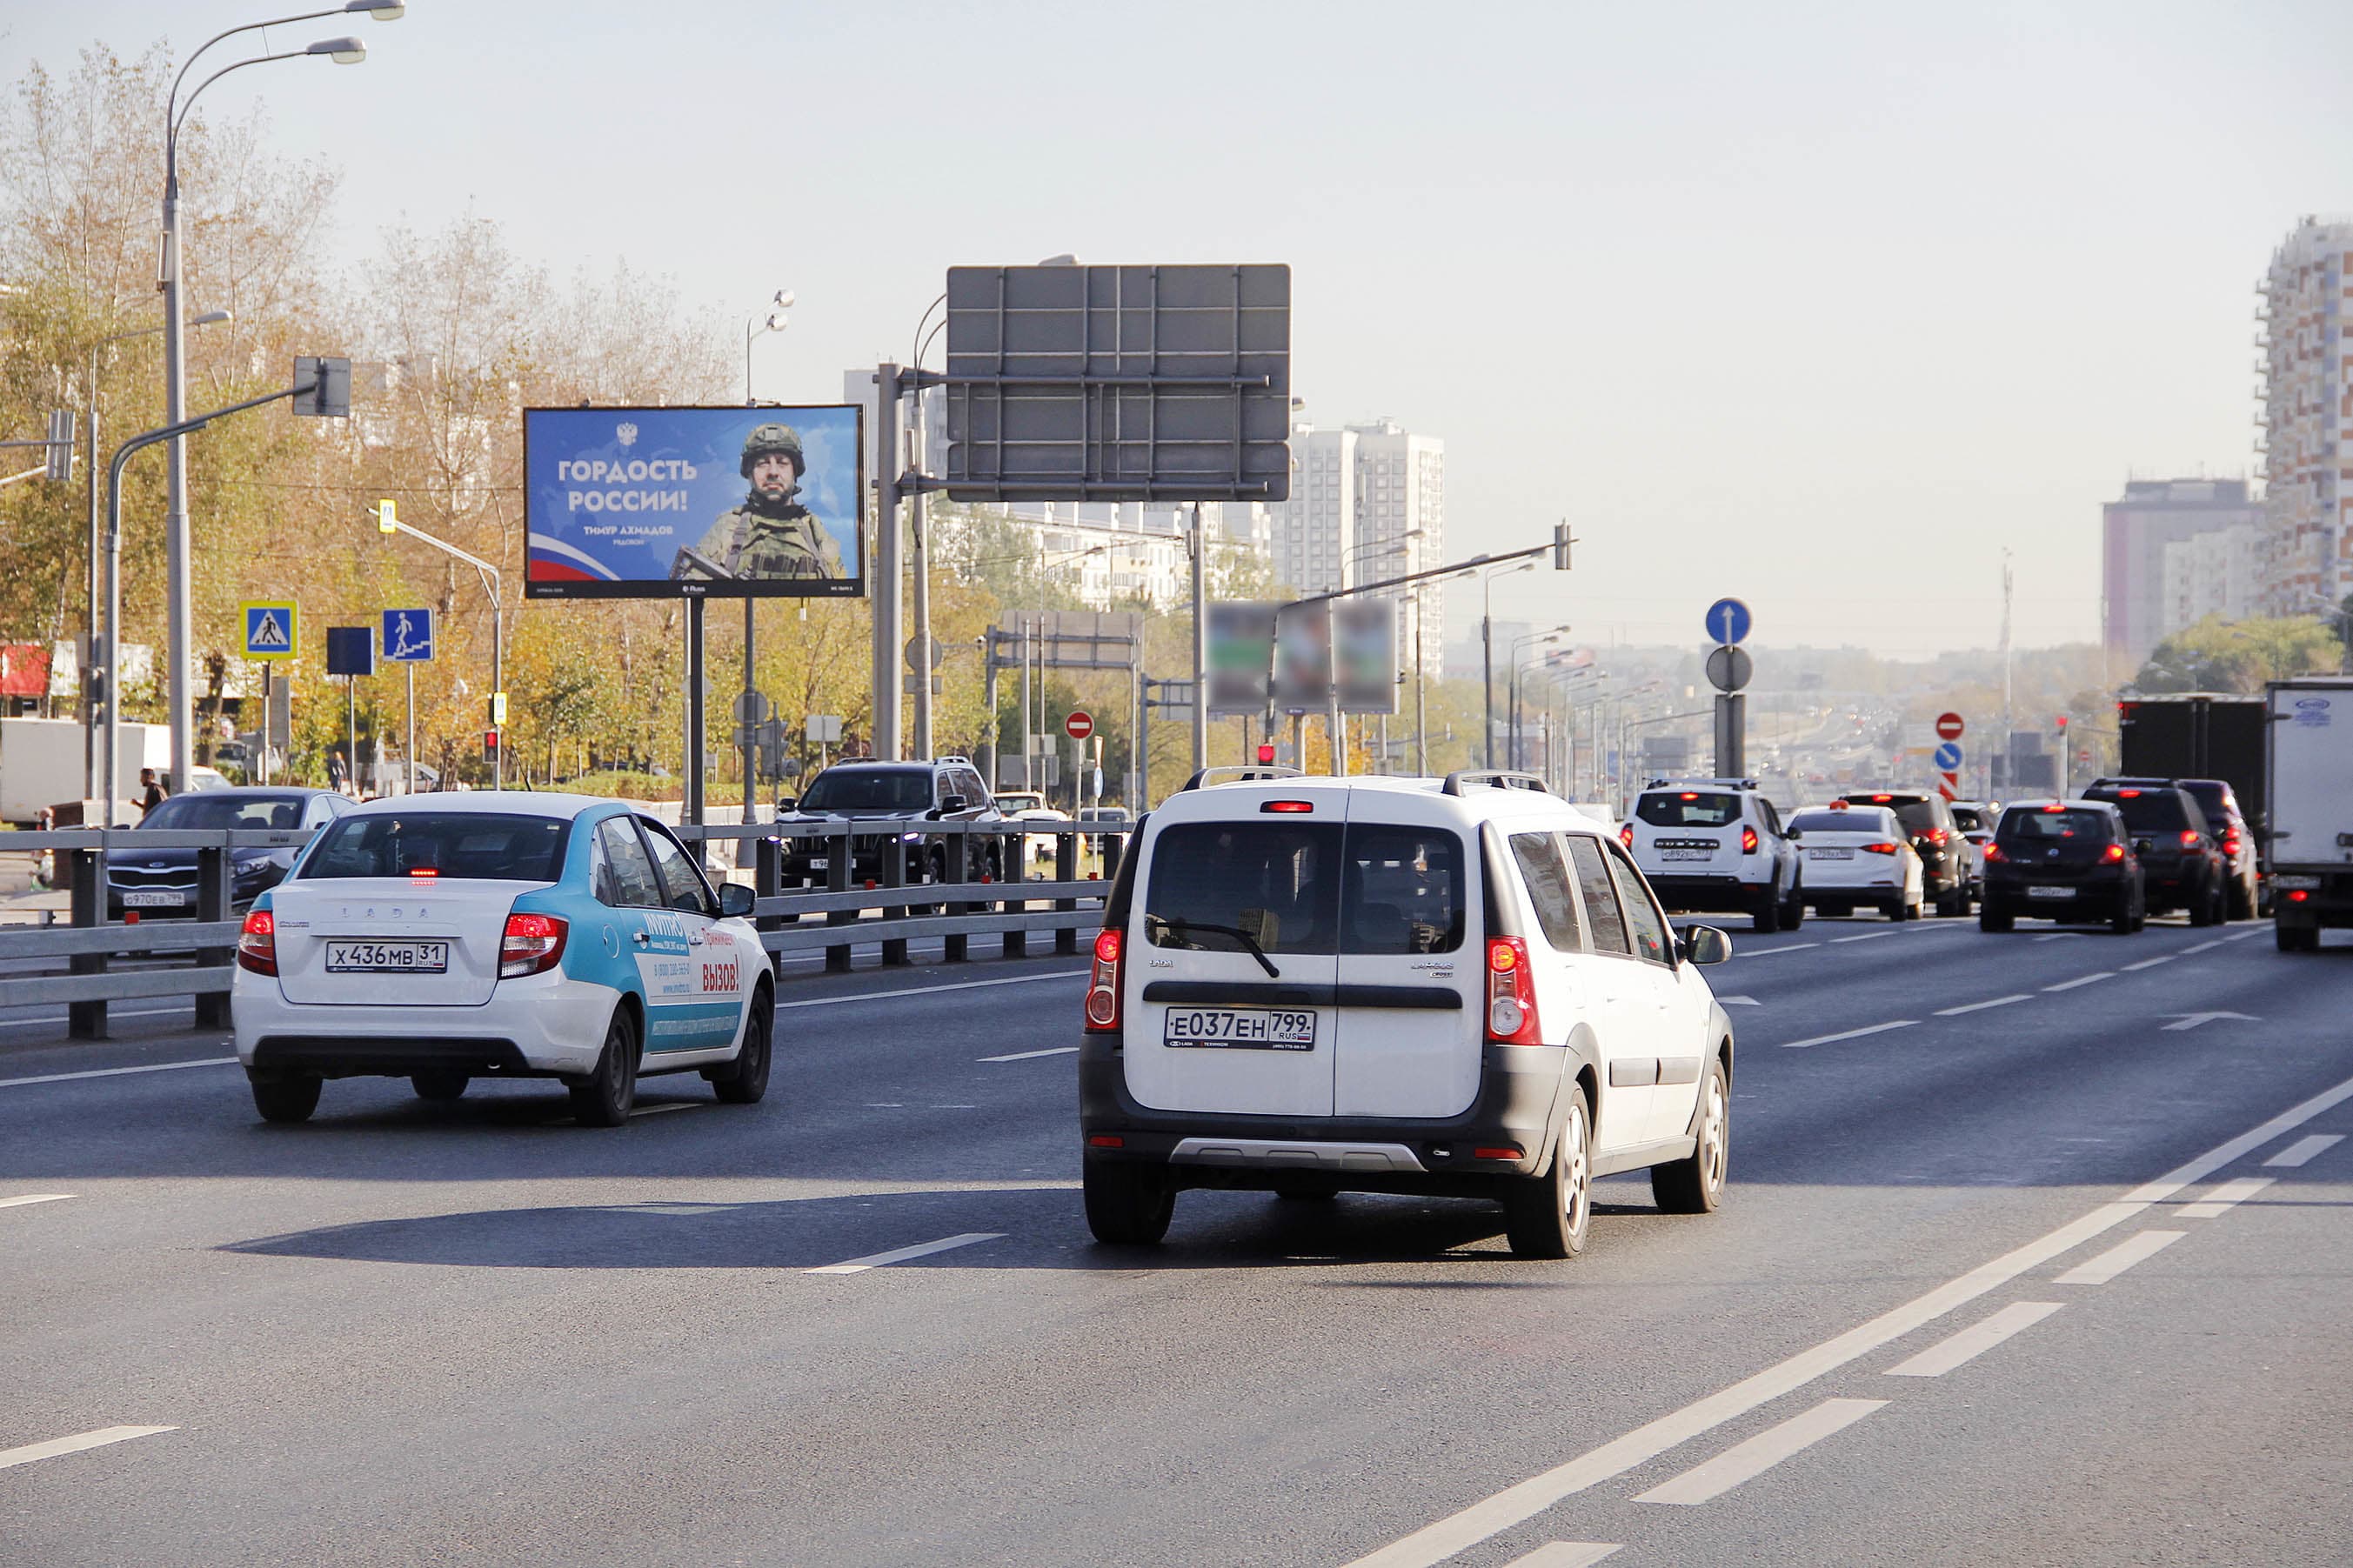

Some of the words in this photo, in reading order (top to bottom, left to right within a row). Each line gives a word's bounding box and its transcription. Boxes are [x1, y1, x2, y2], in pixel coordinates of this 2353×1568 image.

[558, 460, 698, 484] ГОРДОСТЬ
[568, 490, 688, 511] РОССИИ!
[584, 525, 618, 536] ТИМУР
[342, 907, 429, 918] LADA
[643, 913, 684, 937] INVITRO
[419, 945, 439, 960] 31
[703, 953, 739, 991] ВЫЗОВ!
[1148, 959, 1174, 968] LADA
[1174, 1012, 1267, 1038] Е037ЕН
[1272, 1013, 1307, 1032] 799
